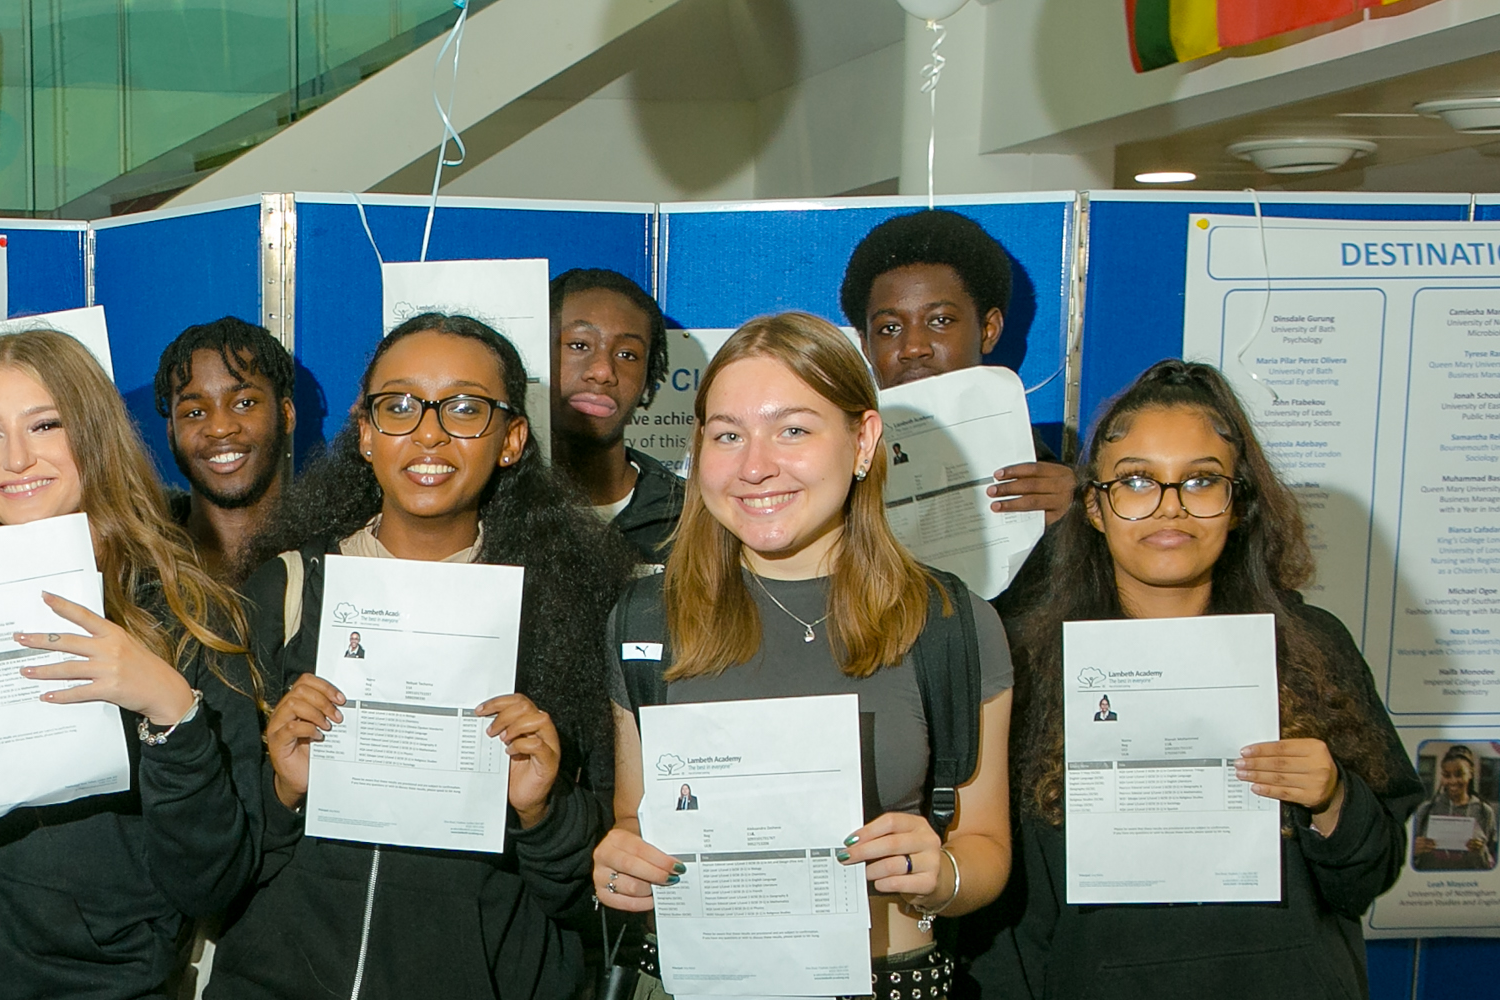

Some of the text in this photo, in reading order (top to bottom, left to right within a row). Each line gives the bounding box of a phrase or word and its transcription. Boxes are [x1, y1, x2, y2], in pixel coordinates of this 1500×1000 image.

[1341, 242, 1500, 266] DESTINATI
[1273, 315, 1335, 324] Dinsdale Gurung
[1446, 319, 1482, 327] University
[1271, 325, 1335, 334] University of Bath
[1282, 336, 1323, 345] Psychology
[1256, 357, 1346, 365] Maria Pilar Perez Olivera
[1428, 361, 1473, 369] Queen Mary
[1268, 367, 1333, 376] University of Bath
[1447, 371, 1479, 379] Business
[1296, 378, 1339, 387] Engineering
[1441, 402, 1487, 411] University of
[1264, 409, 1332, 418] University of Leeds
[654, 411, 695, 426] achie
[1255, 419, 1341, 428] nterdisciplinary Science
[640, 434, 656, 448] of
[659, 433, 687, 448] this
[1295, 440, 1328, 448] Adebayo
[1314, 450, 1341, 458] London
[1465, 454, 1499, 462] Sociology
[1299, 461, 1326, 469] Science
[1420, 485, 1465, 494] Queen Mary
[1459, 537, 1485, 545] College
[1439, 547, 1474, 555] University
[1430, 557, 1458, 565] Nursing
[1448, 587, 1477, 595] Michael
[1424, 598, 1460, 606] University
[361, 608, 384, 616] Lambeth
[1434, 608, 1471, 616] Marketing
[1109, 670, 1163, 678] Lambeth Academy
